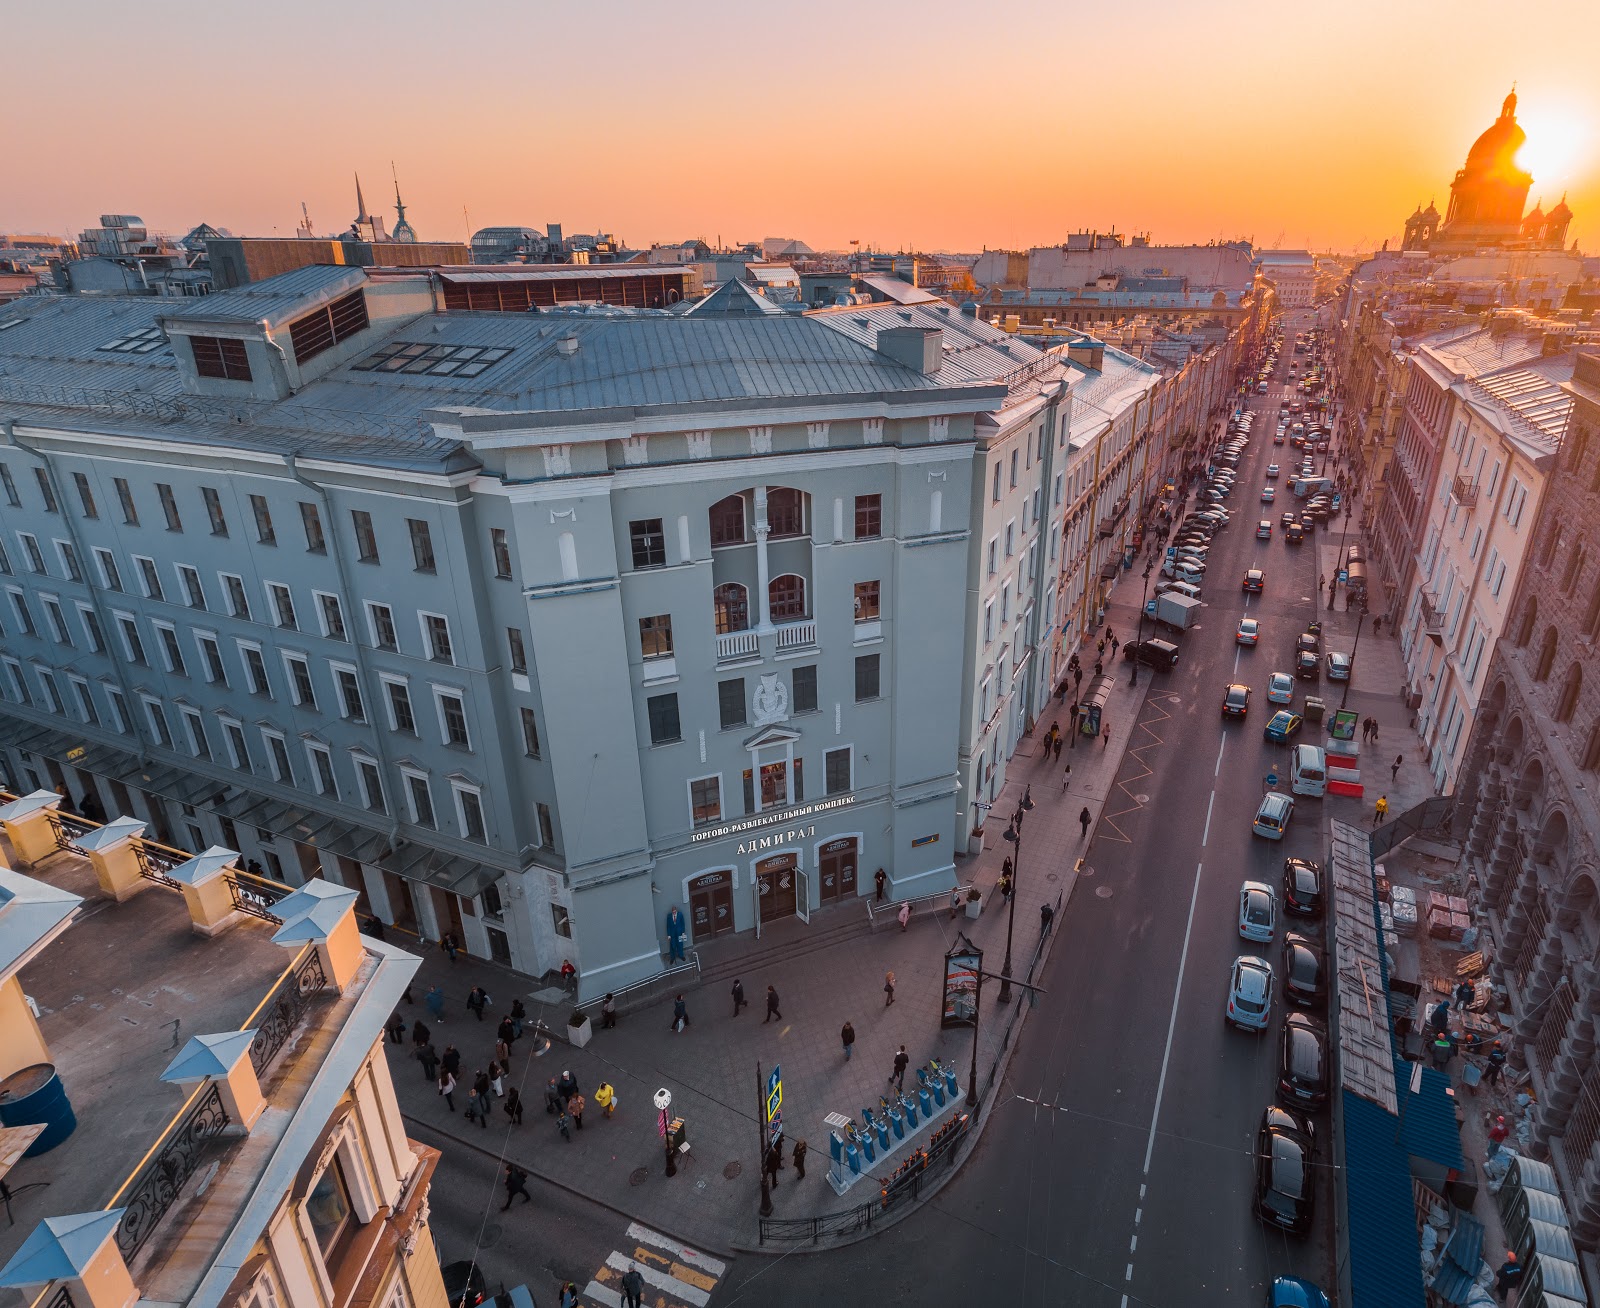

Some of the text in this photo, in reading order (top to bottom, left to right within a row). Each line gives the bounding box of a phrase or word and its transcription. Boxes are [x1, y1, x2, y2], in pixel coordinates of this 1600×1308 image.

[691, 795, 856, 842] ТОРГОВО-РАЗВЛЕКАТЕЛЬНЫЙ КОМПЛЕКС
[736, 825, 815, 855] АДМИРАЛ
